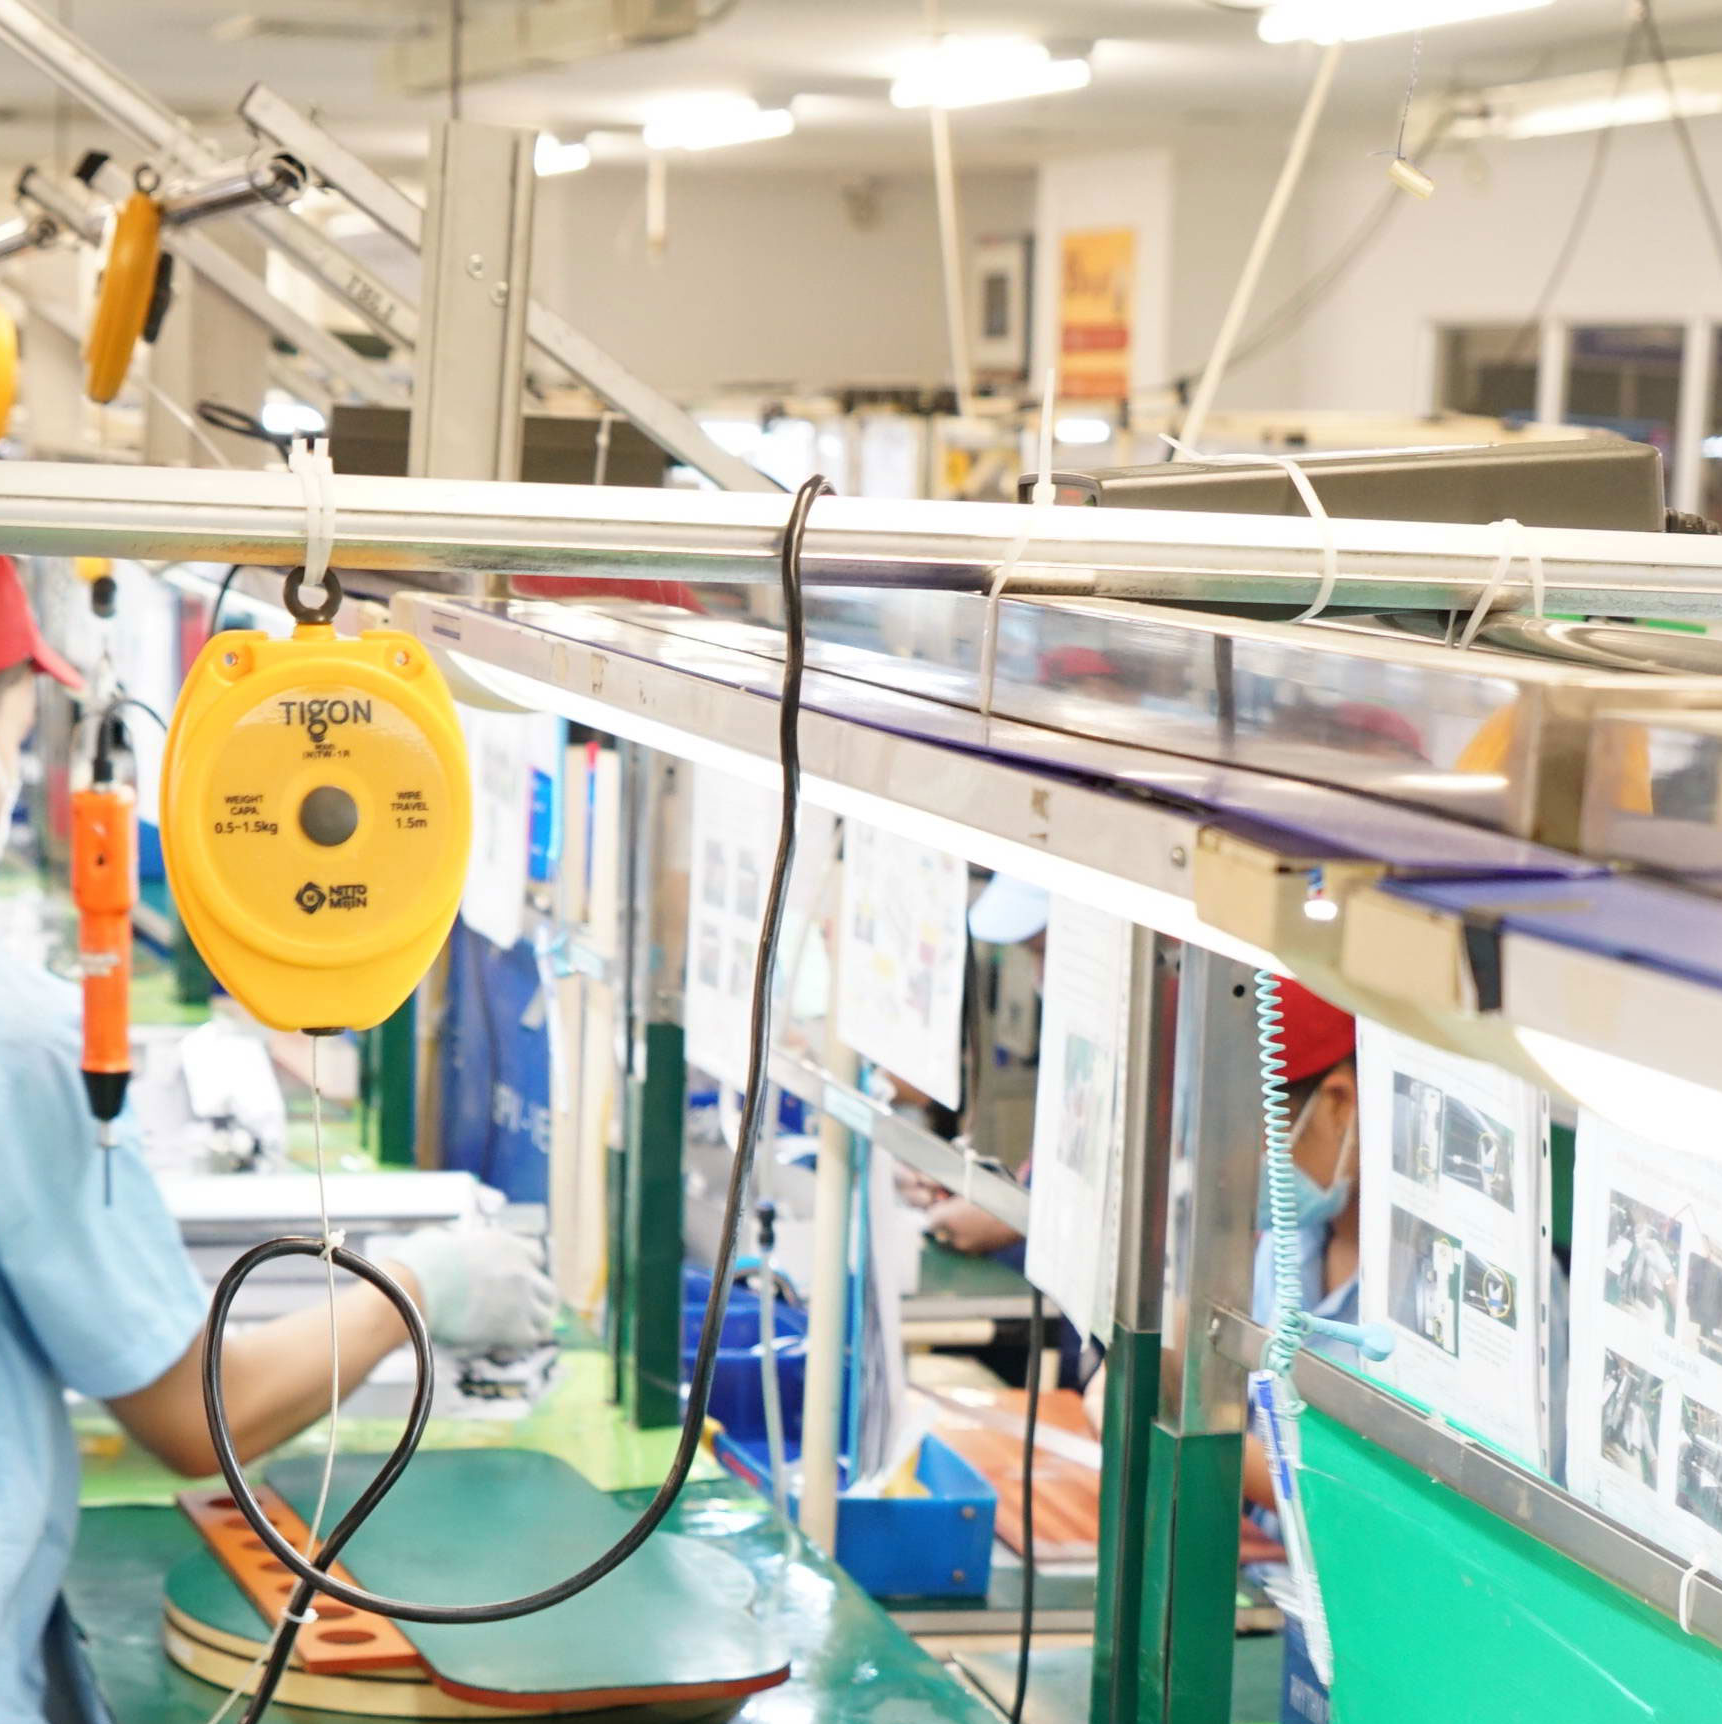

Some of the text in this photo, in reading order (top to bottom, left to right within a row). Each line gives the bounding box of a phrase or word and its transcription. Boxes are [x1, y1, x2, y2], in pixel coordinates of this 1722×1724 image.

[224, 795, 264, 805] WEIGHT
[397, 791, 422, 801] WIRE
[390, 802, 429, 812] TRAVEL
[396, 817, 427, 829] 1.5m
